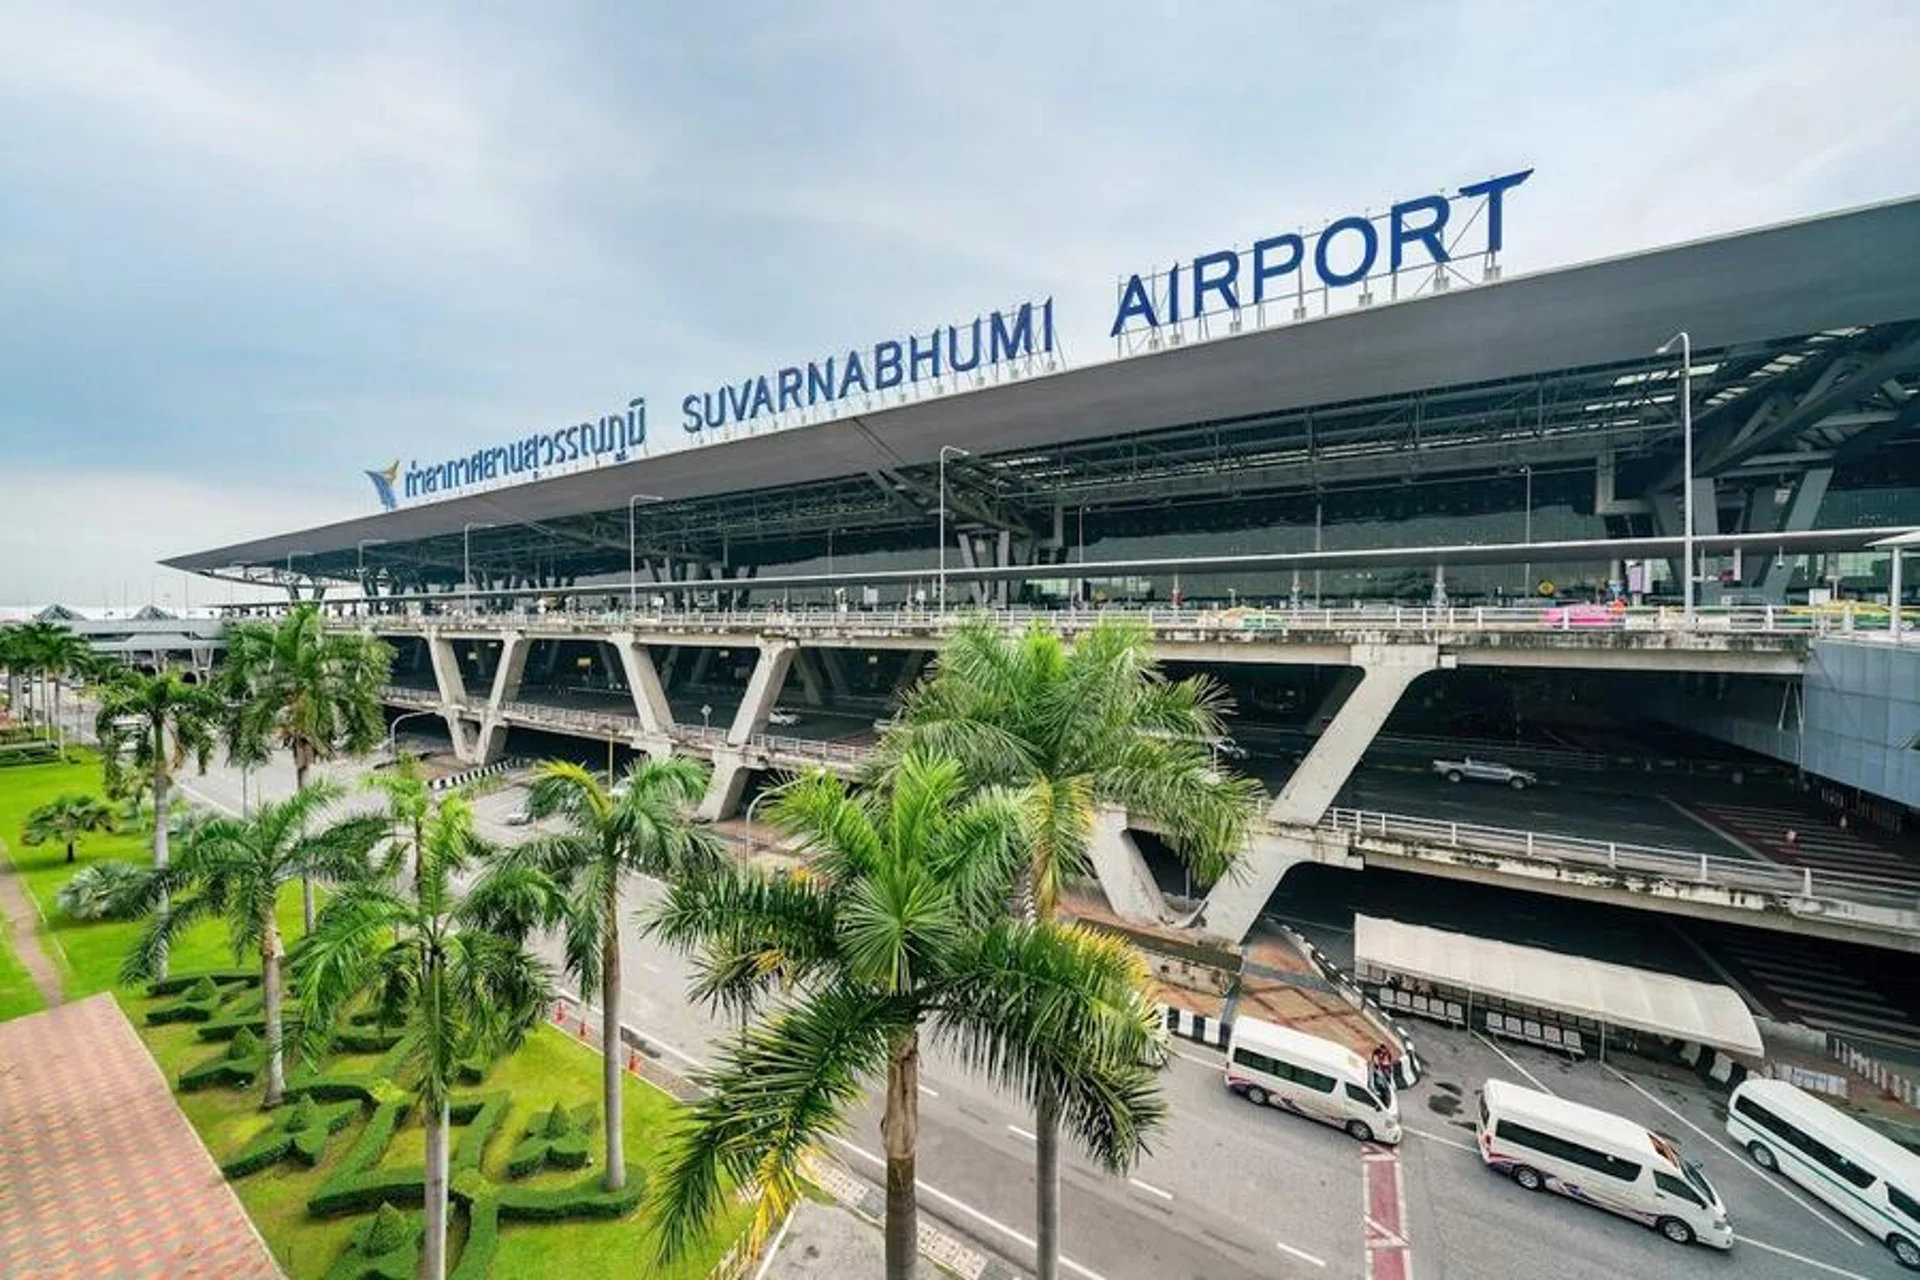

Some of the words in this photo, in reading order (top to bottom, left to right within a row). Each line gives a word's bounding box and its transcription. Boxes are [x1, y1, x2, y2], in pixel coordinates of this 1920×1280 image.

[682, 296, 1053, 434] SUVARNABHUMI
[1110, 168, 1535, 338] AIRPORT
[404, 396, 647, 498] ท่าอากาศยานสุวรรณภูมิ
